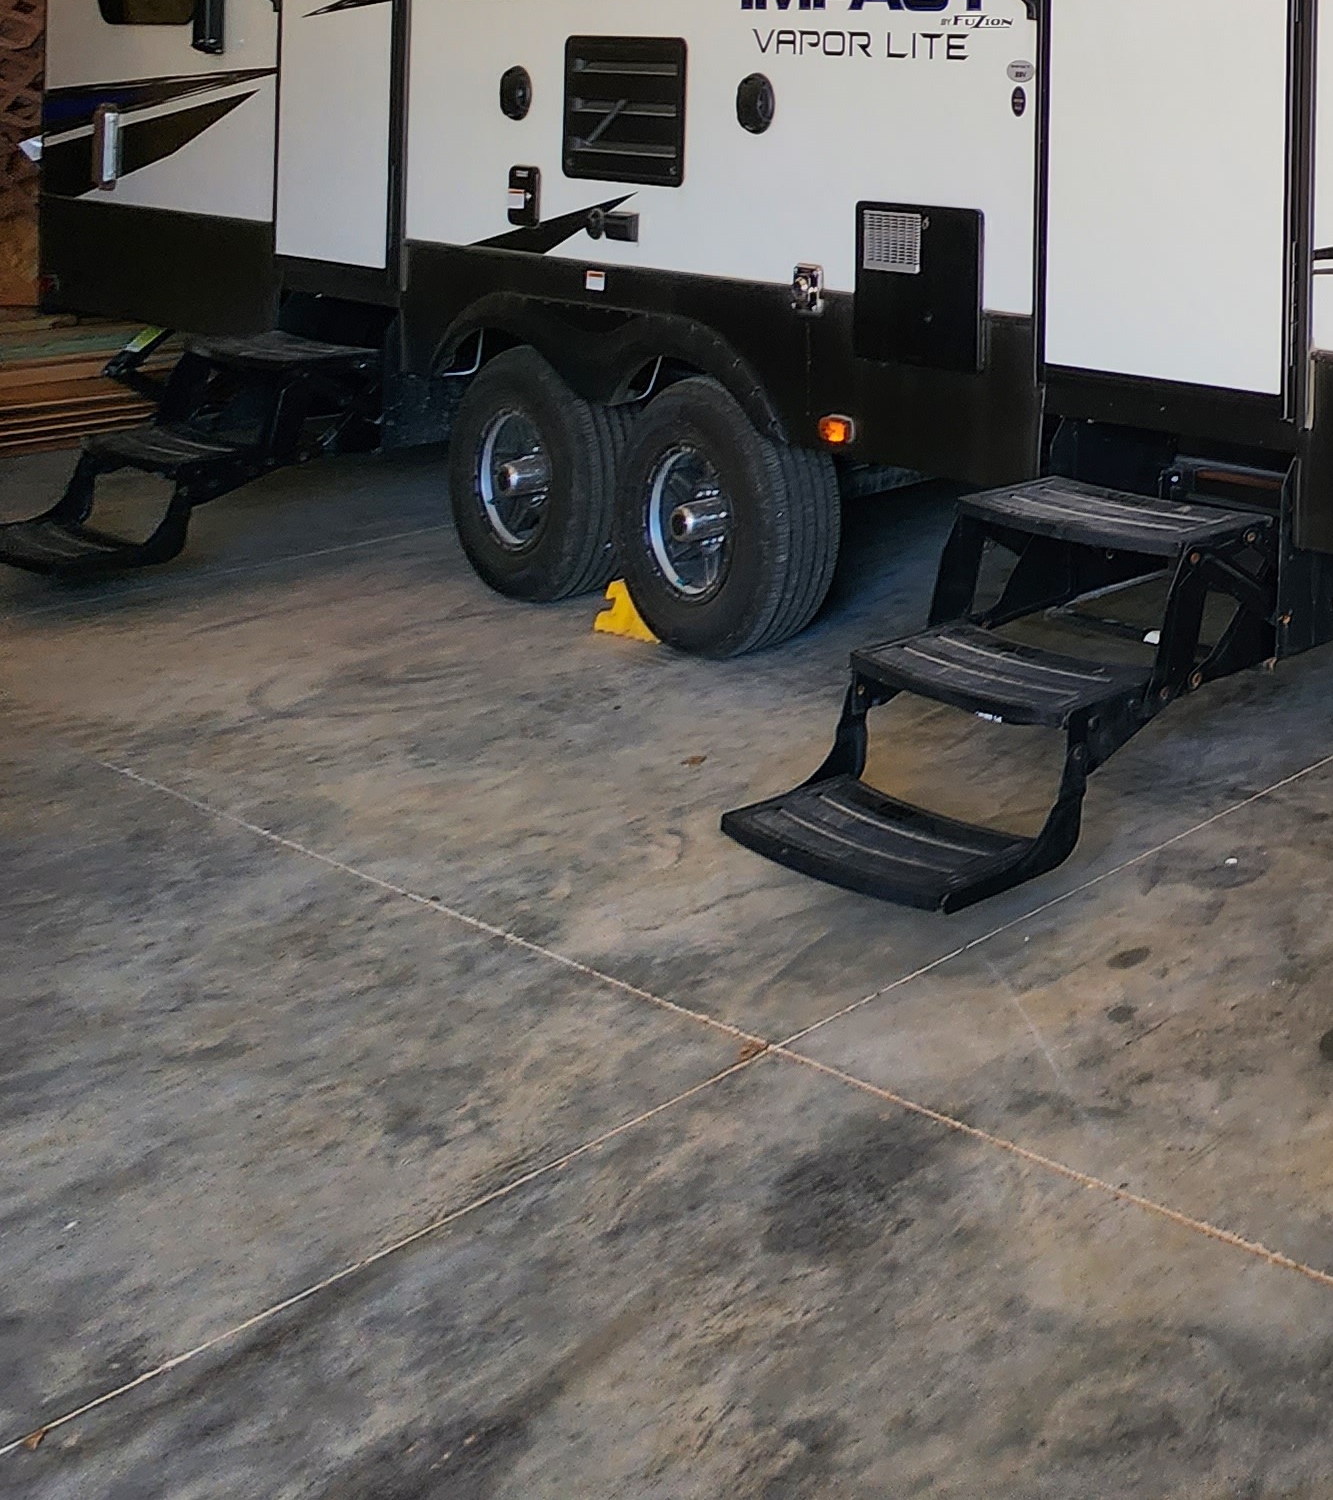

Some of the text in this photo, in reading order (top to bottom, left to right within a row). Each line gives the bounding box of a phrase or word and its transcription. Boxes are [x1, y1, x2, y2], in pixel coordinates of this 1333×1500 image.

[940, 18, 952, 26] BY
[752, 29, 970, 60] VAPOR LITE
